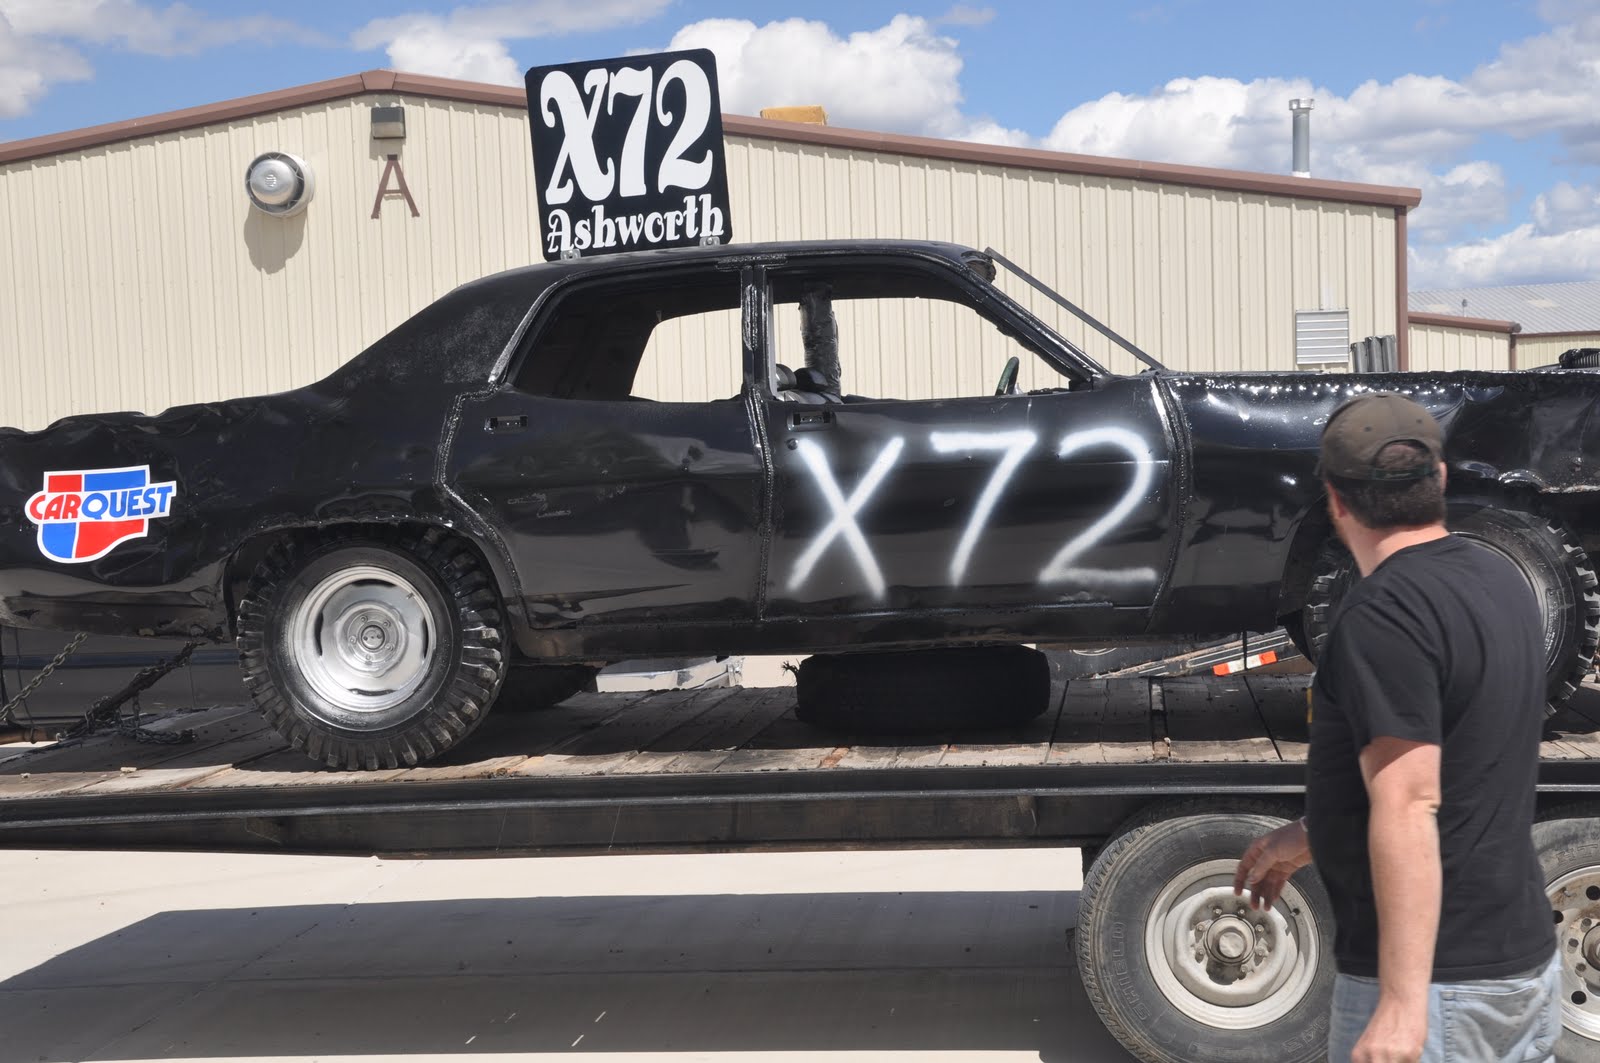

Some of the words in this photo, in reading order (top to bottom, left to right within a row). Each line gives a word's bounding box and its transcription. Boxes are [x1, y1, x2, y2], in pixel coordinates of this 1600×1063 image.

[540, 59, 713, 205] X72
[371, 154, 420, 219] A
[547, 194, 724, 253] Ashworth
[29, 485, 173, 520] CARQUEST
[786, 427, 1157, 600] X72
